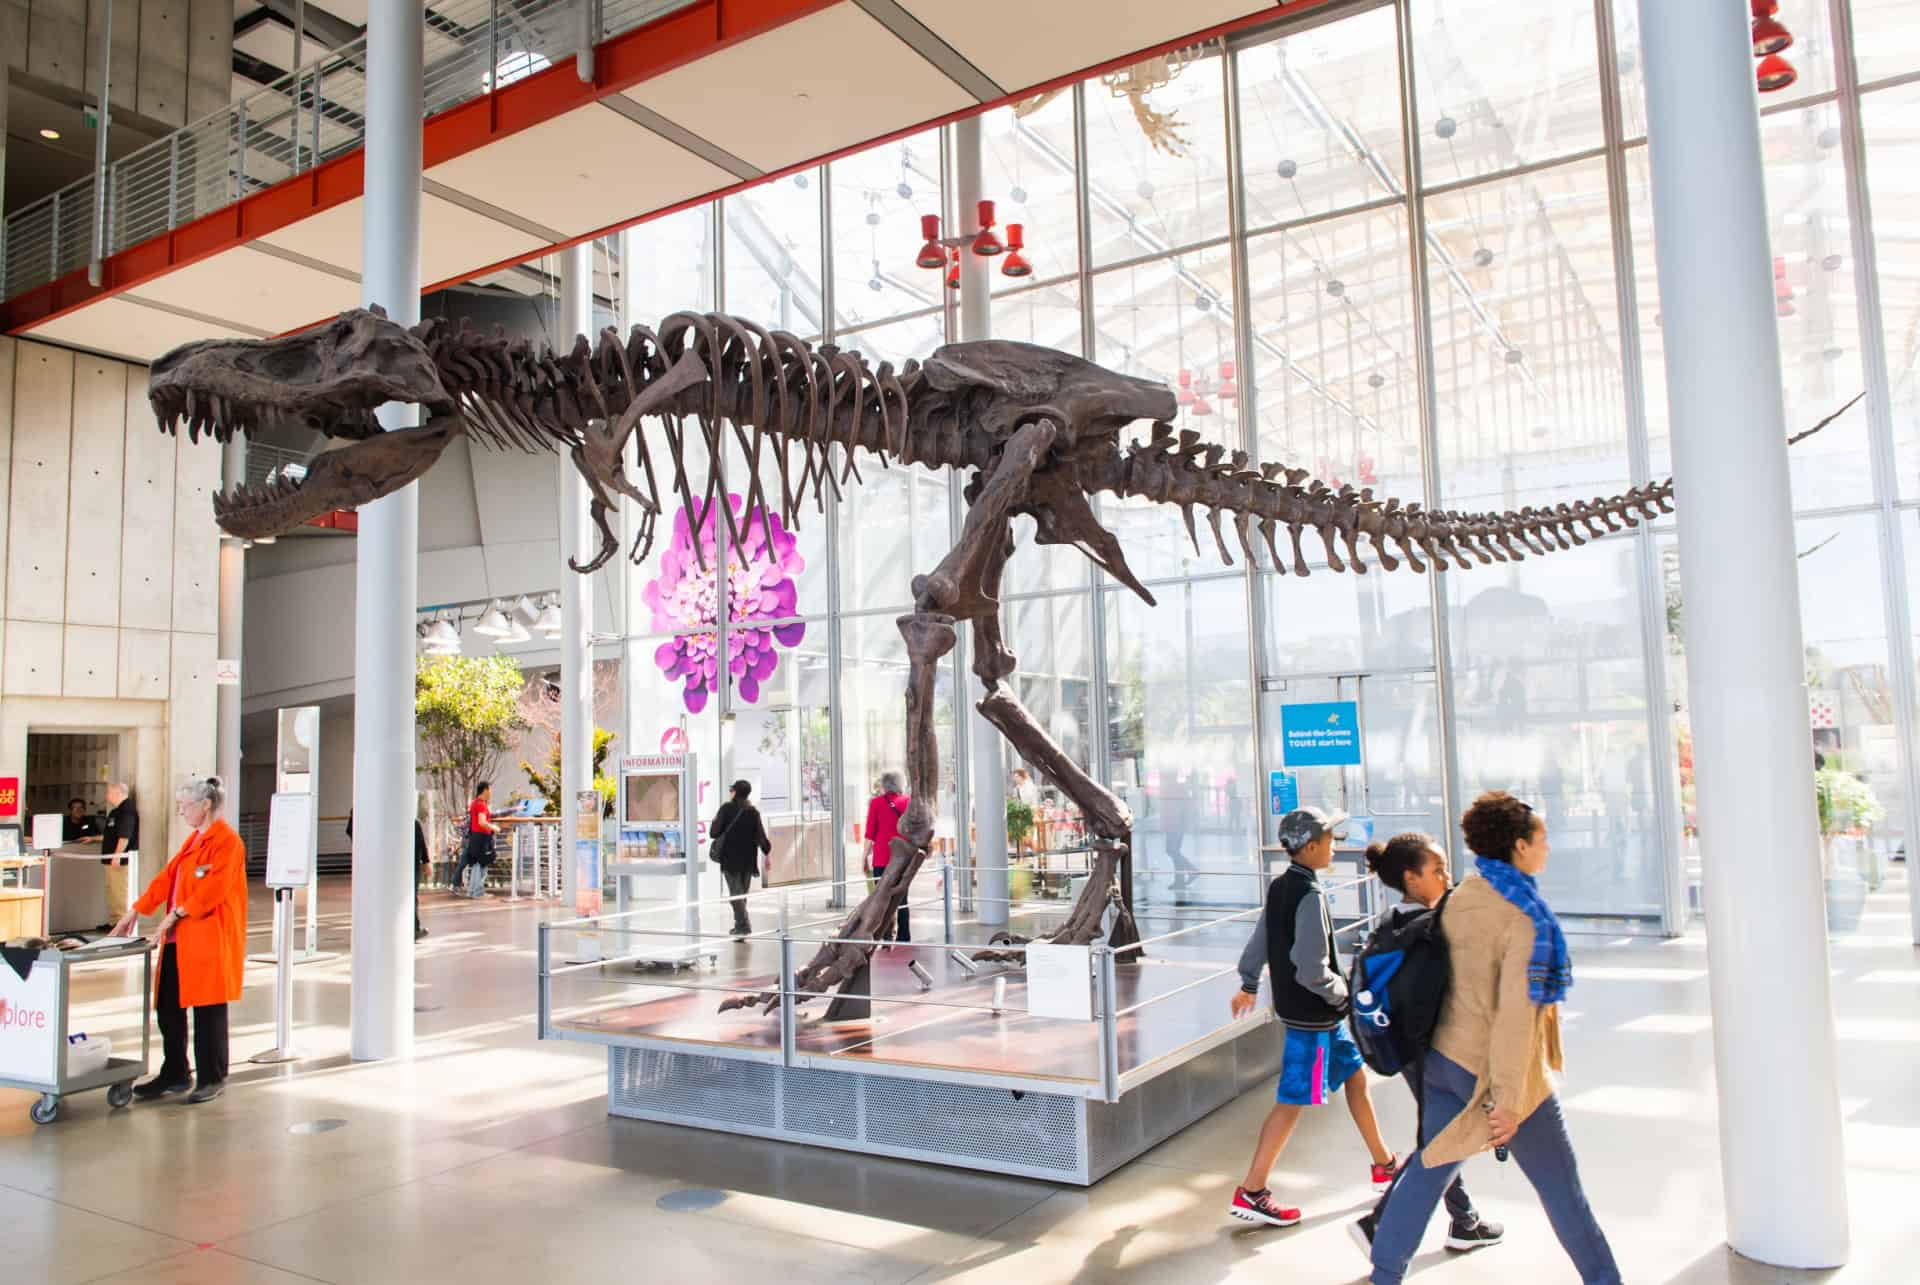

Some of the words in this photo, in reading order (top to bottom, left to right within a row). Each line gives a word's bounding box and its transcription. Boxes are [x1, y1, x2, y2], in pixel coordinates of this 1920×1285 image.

[1288, 729, 1351, 738] Behind-the-Scenes
[1288, 739, 1316, 747] TOURS
[1318, 739, 1334, 747] start
[1336, 738, 1352, 746] here
[622, 757, 682, 768] INFORMATION
[1, 1000, 45, 1030] plore
